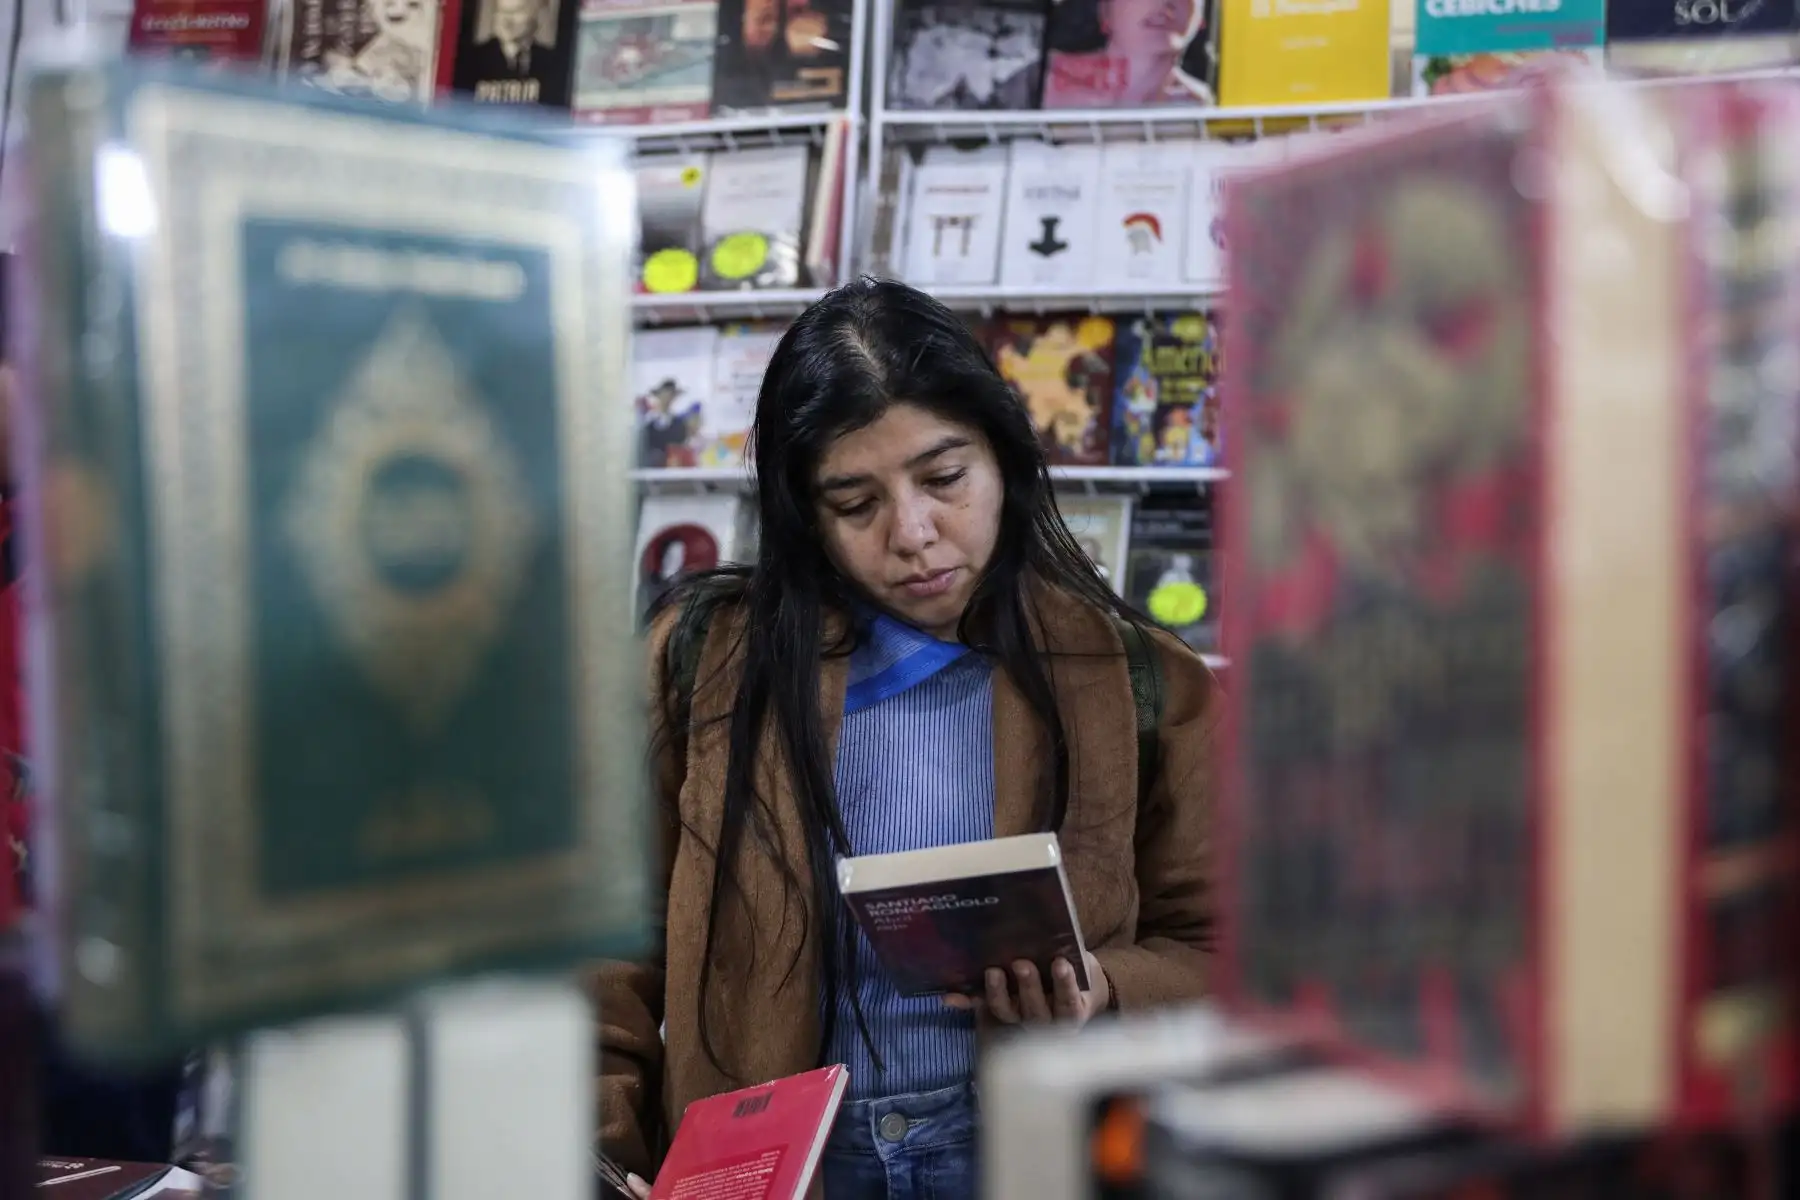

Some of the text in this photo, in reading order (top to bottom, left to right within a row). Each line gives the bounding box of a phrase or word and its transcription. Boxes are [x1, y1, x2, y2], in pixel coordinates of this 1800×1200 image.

[1674, 0, 1738, 25] SOL
[864, 893, 957, 910] SANTIAGO
[868, 896, 1000, 918] RONCAGLIOLO
